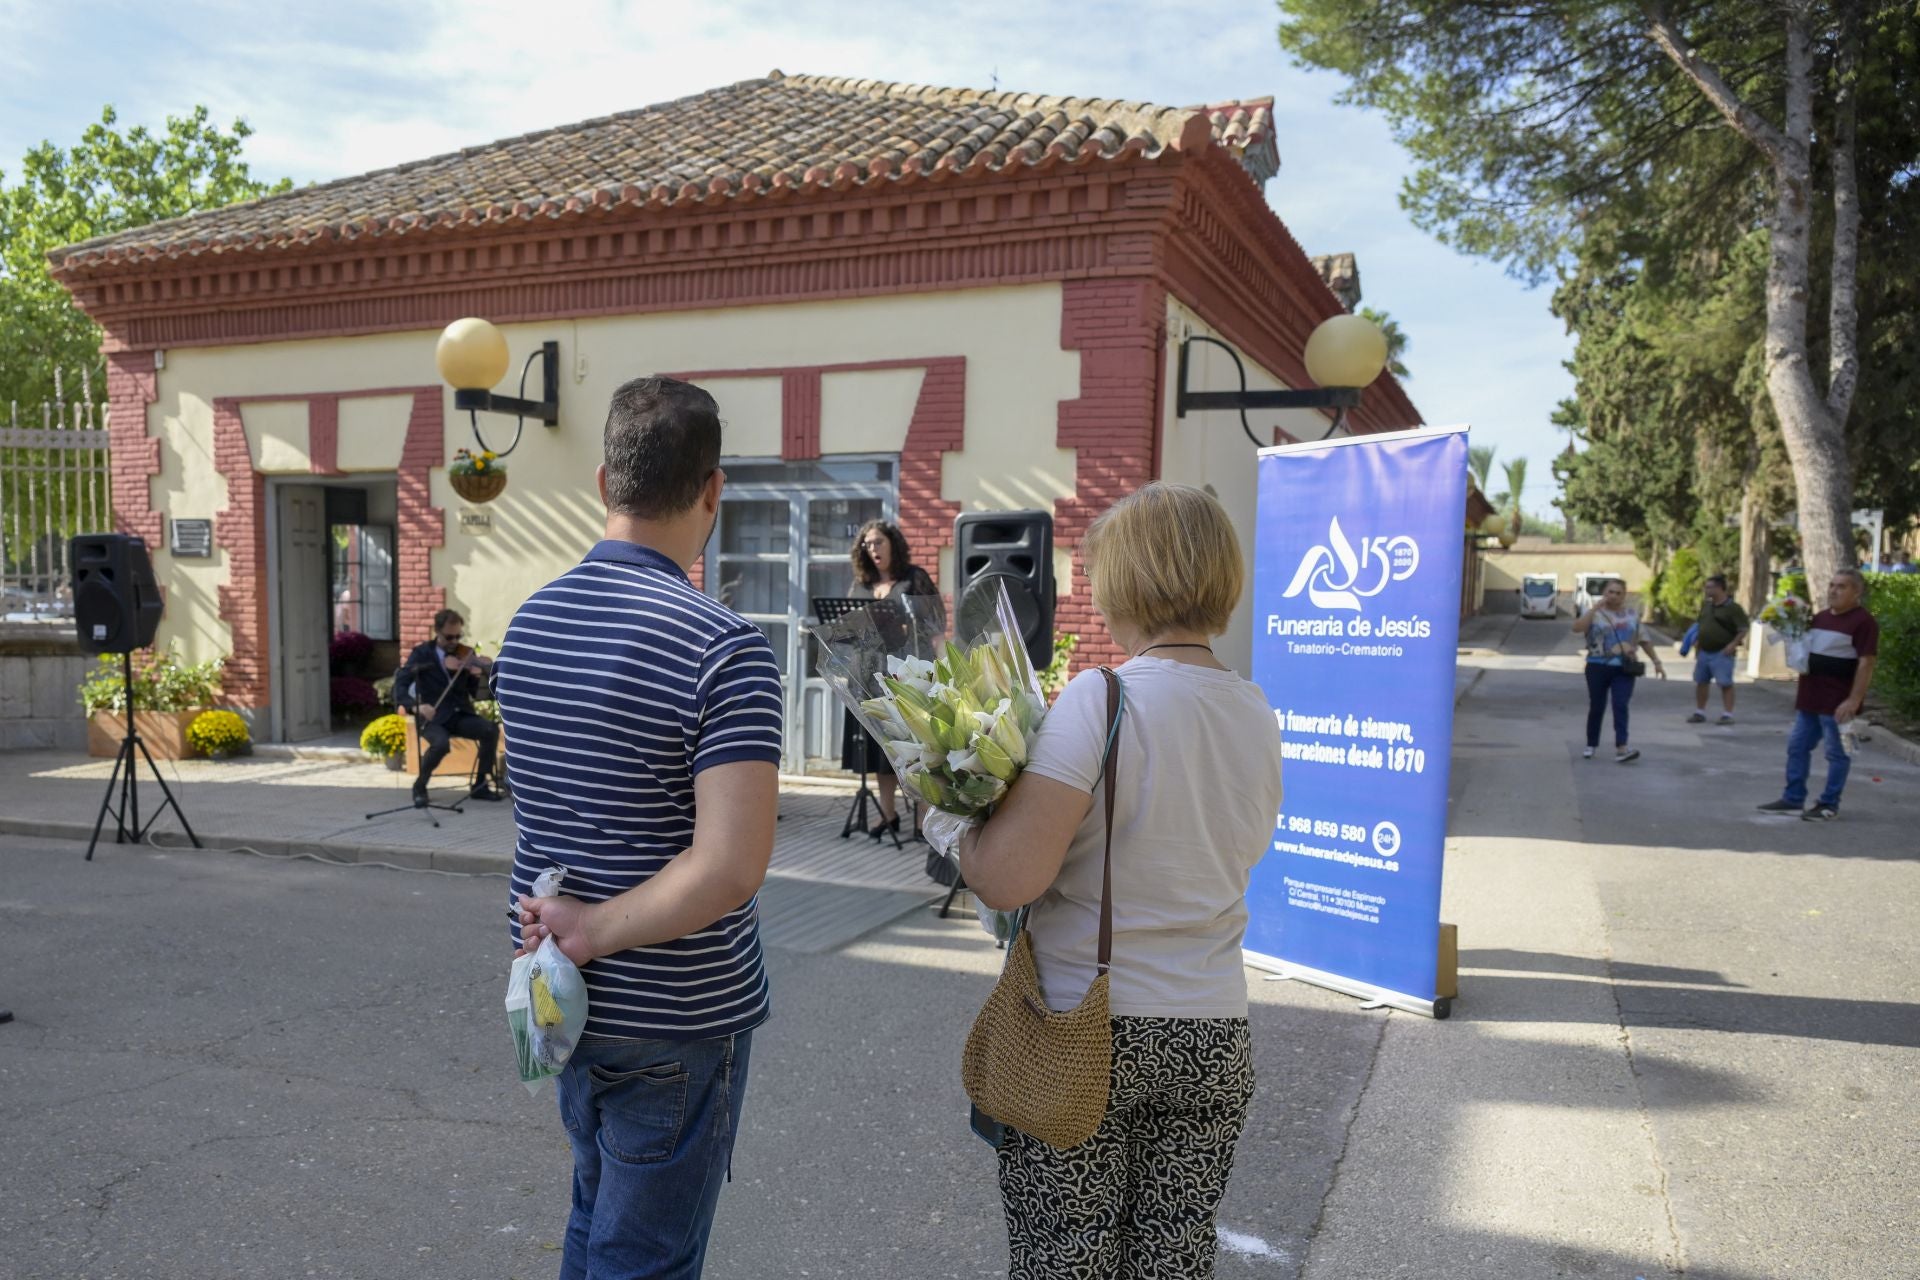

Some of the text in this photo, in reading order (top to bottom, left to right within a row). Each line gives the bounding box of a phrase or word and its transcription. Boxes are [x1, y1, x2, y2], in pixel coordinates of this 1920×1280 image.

[1267, 614, 1431, 638] Funeraria de Jesús
[1286, 641, 1404, 657] Tanatorio-Crematorio
[1286, 709, 1342, 736] funeraria
[1343, 713, 1359, 737] de
[1361, 716, 1414, 745] siempre,
[1347, 743, 1383, 769] desde
[1387, 746, 1425, 774] 1870
[1288, 816, 1311, 834] 968
[1313, 820, 1338, 838] 859
[1340, 824, 1366, 843] 580
[1377, 833, 1396, 845] 24H
[1273, 841, 1399, 872] www.funerariadejesus.es
[1342, 889, 1352, 898] de
[1352, 890, 1386, 906] Espinardo
[1356, 901, 1379, 914] Murcia
